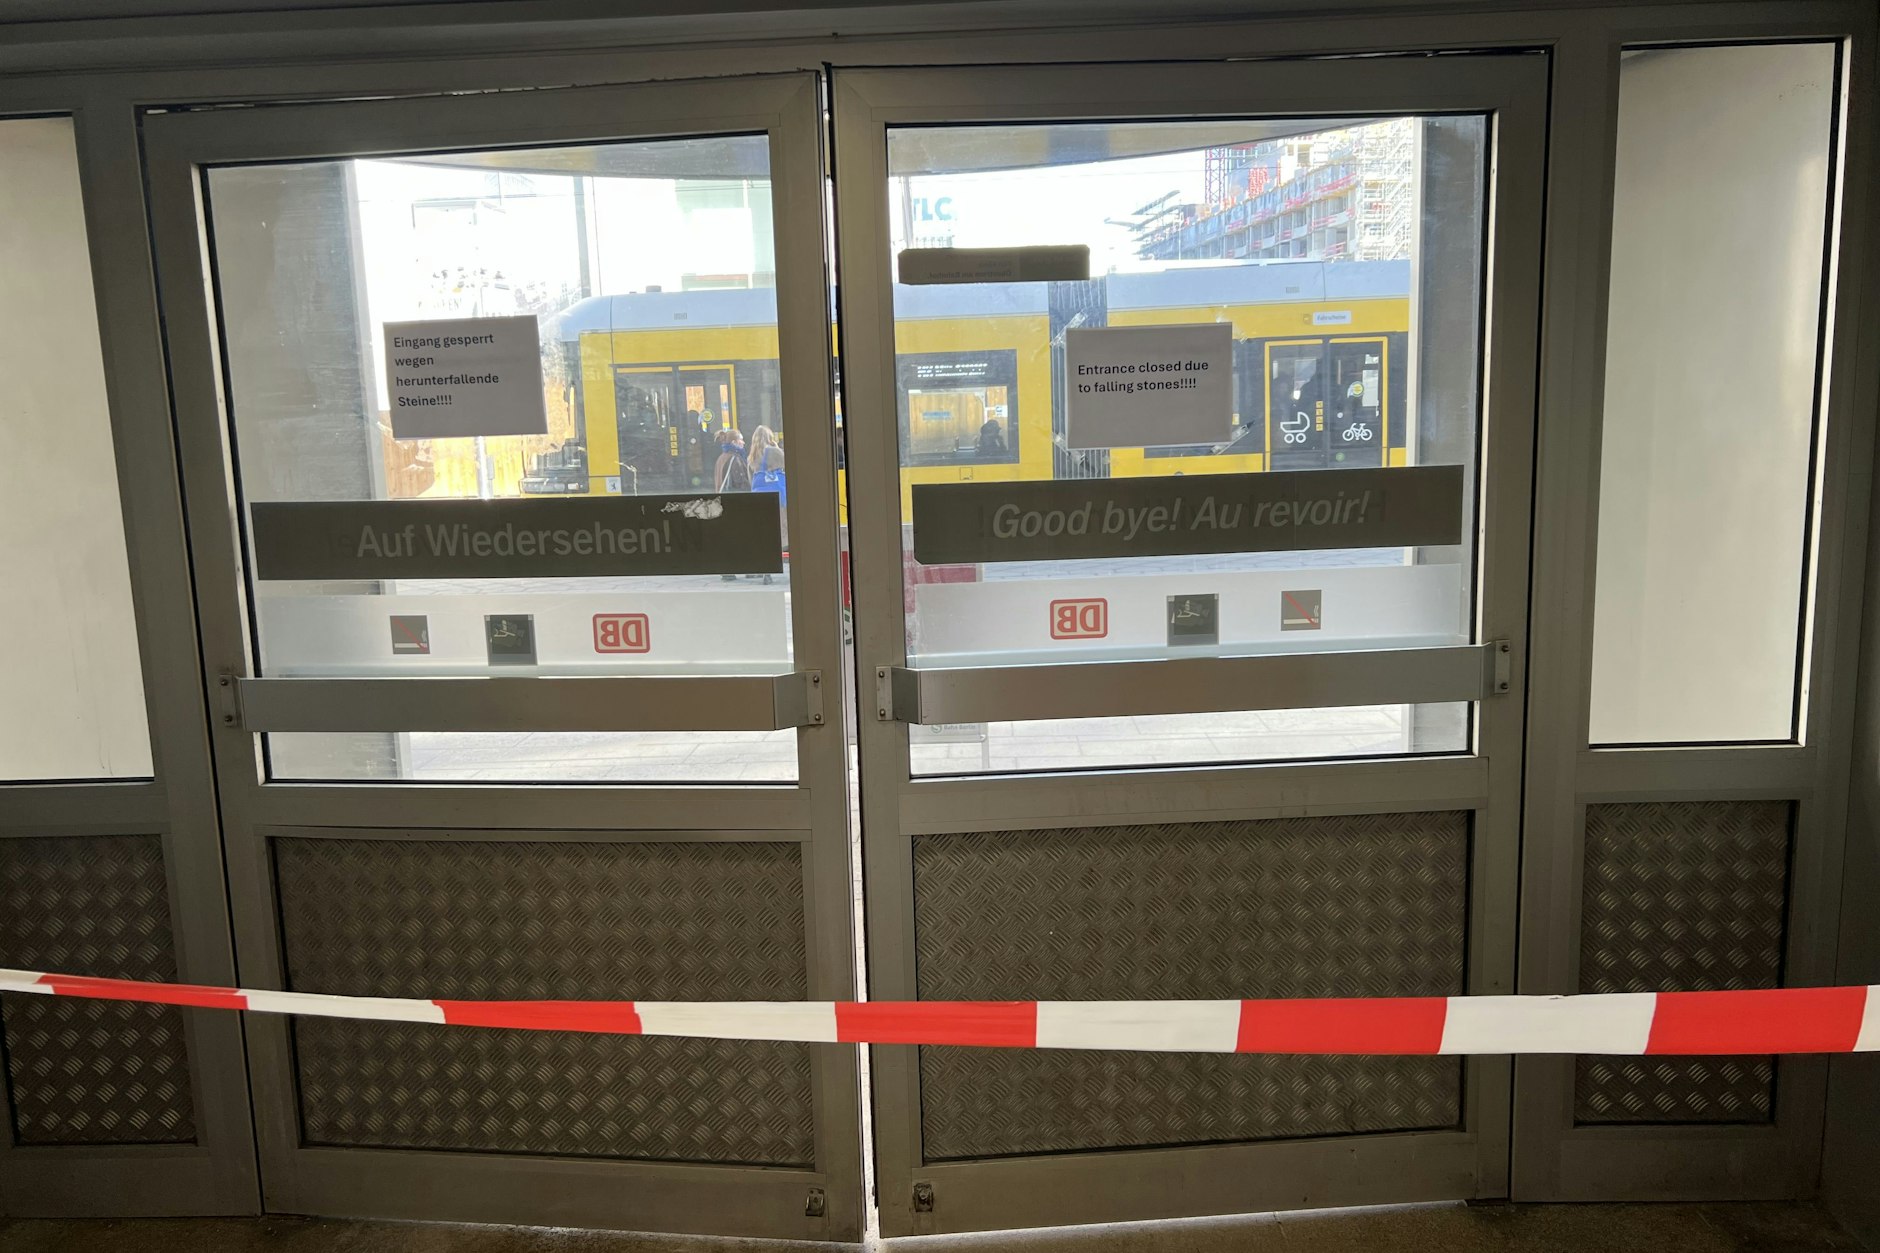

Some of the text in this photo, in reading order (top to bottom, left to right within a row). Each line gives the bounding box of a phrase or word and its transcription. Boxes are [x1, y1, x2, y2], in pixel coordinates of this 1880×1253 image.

[394, 334, 494, 349] Eingang gesperrt
[395, 356, 434, 368] wegen
[1078, 360, 1209, 375] Entrance closed due
[396, 373, 499, 387] herunterfallende
[1078, 378, 1196, 393] to falling stones!!!!
[398, 394, 453, 407] Steine!!!!
[992, 490, 1372, 541] Good bye! Au revoir!
[356, 523, 415, 558] Auf
[424, 519, 672, 558] Wiedersehen!
